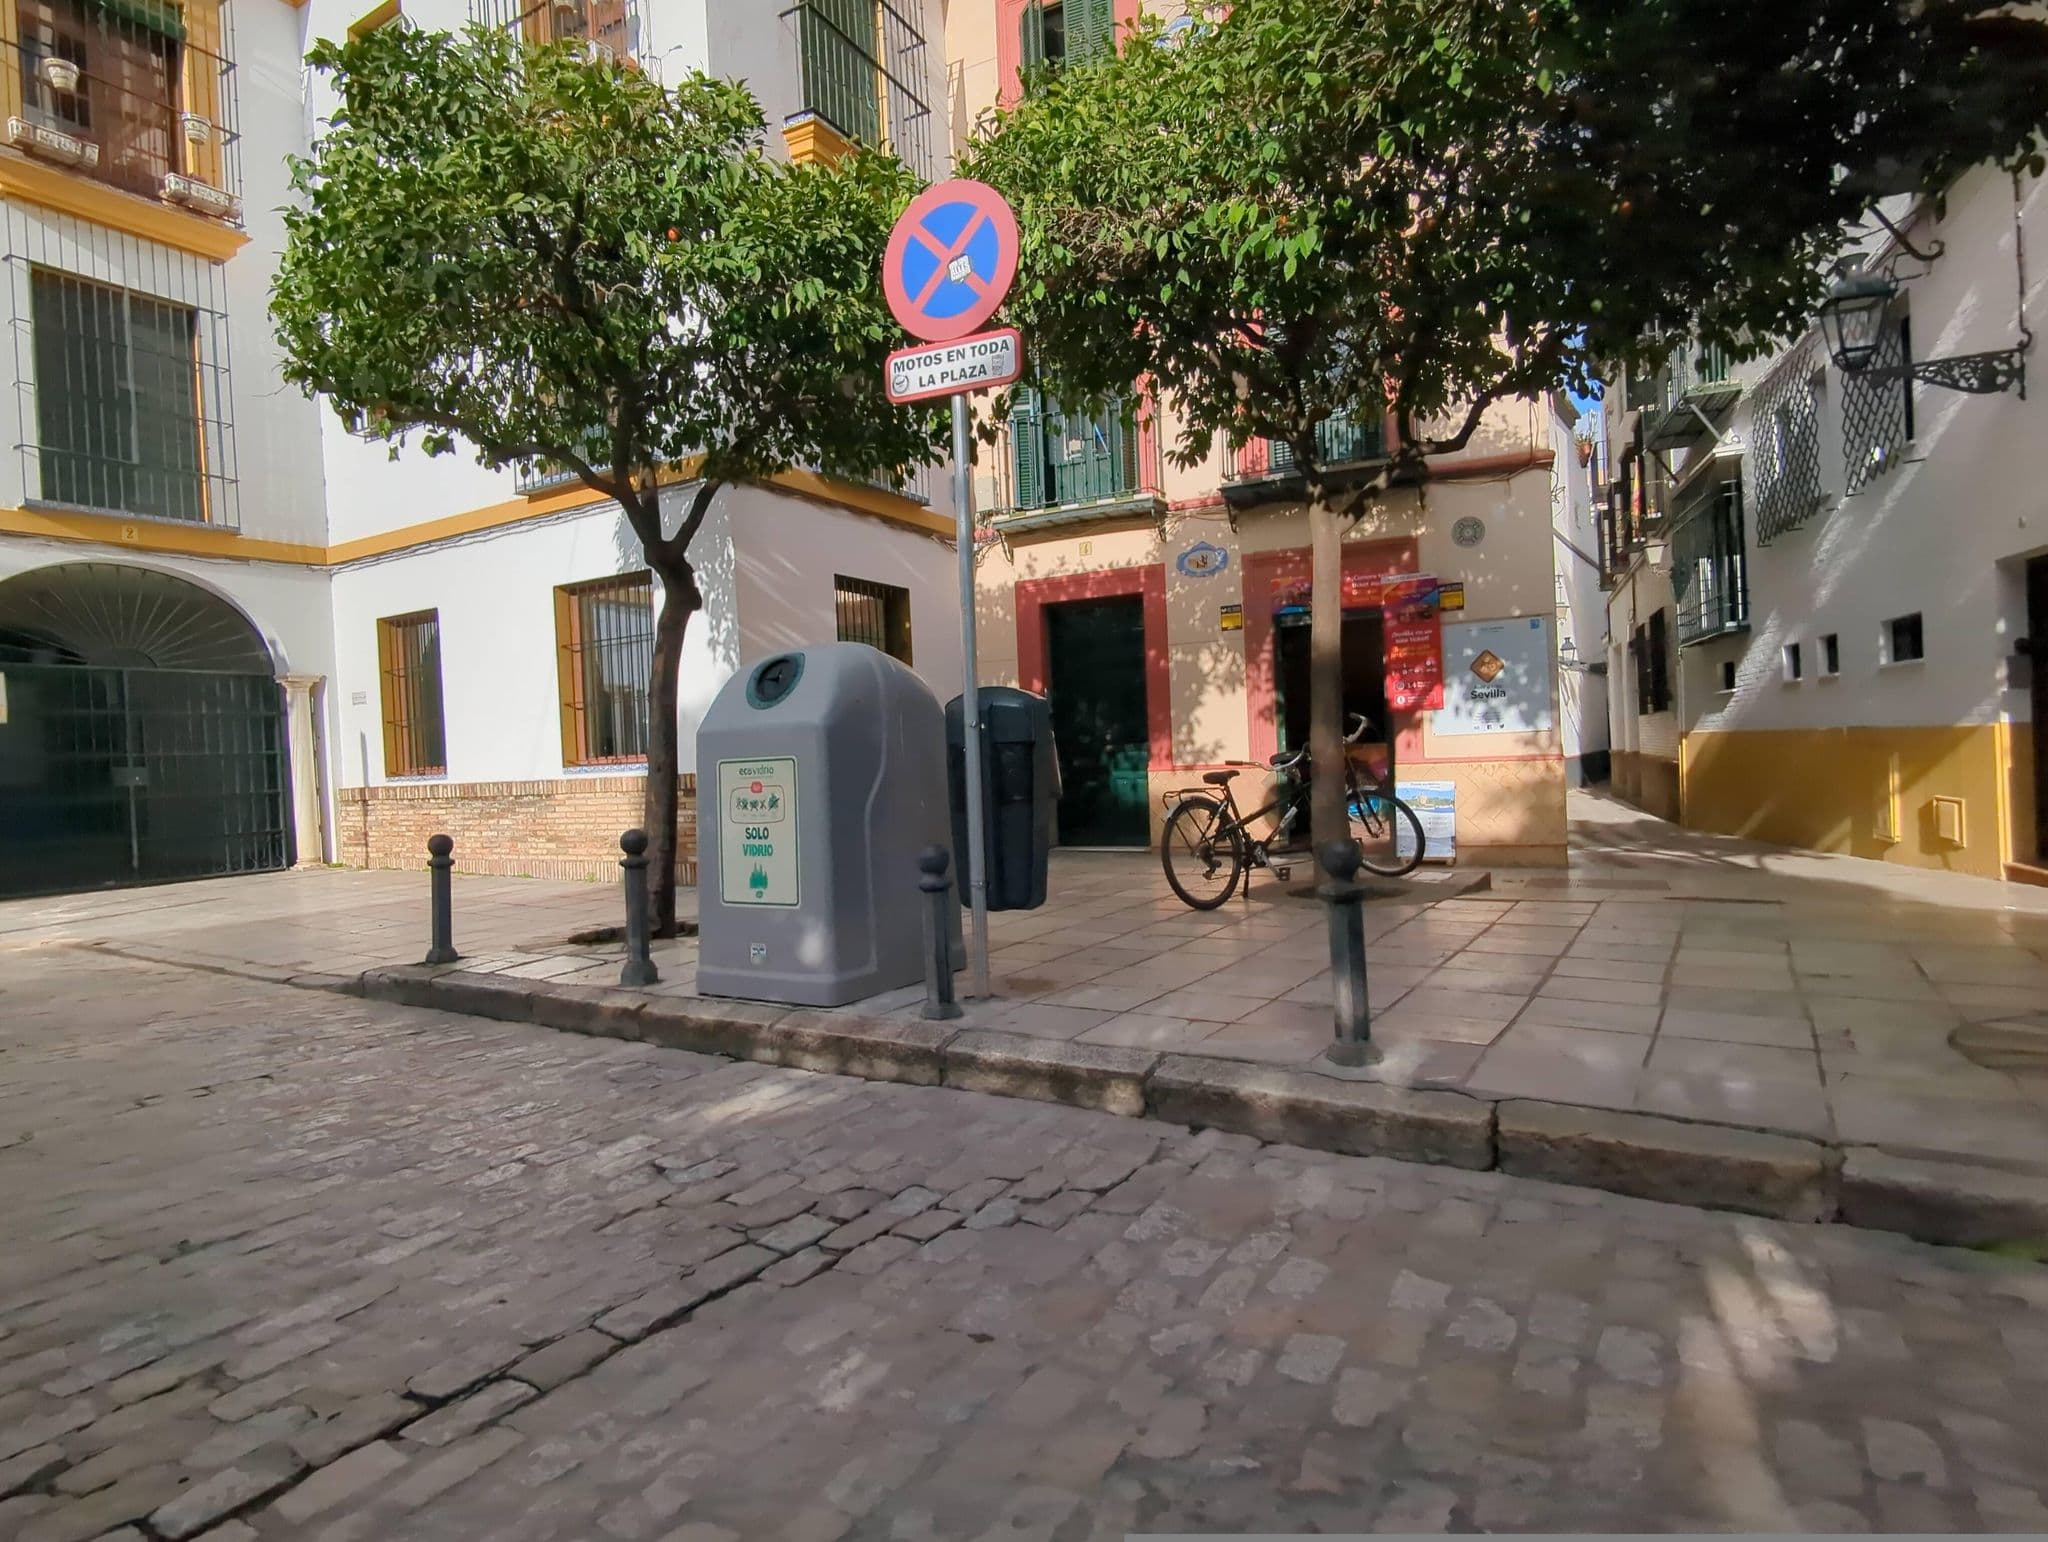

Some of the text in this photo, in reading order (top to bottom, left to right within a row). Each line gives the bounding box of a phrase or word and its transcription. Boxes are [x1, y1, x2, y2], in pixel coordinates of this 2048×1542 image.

[893, 339, 1010, 374] MOTOS EN TODA
[919, 364, 987, 388] LA PLAZA
[1471, 688, 1506, 699] Sevilla
[745, 827, 769, 840] SOLO
[742, 844, 774, 857] VIDRIO
